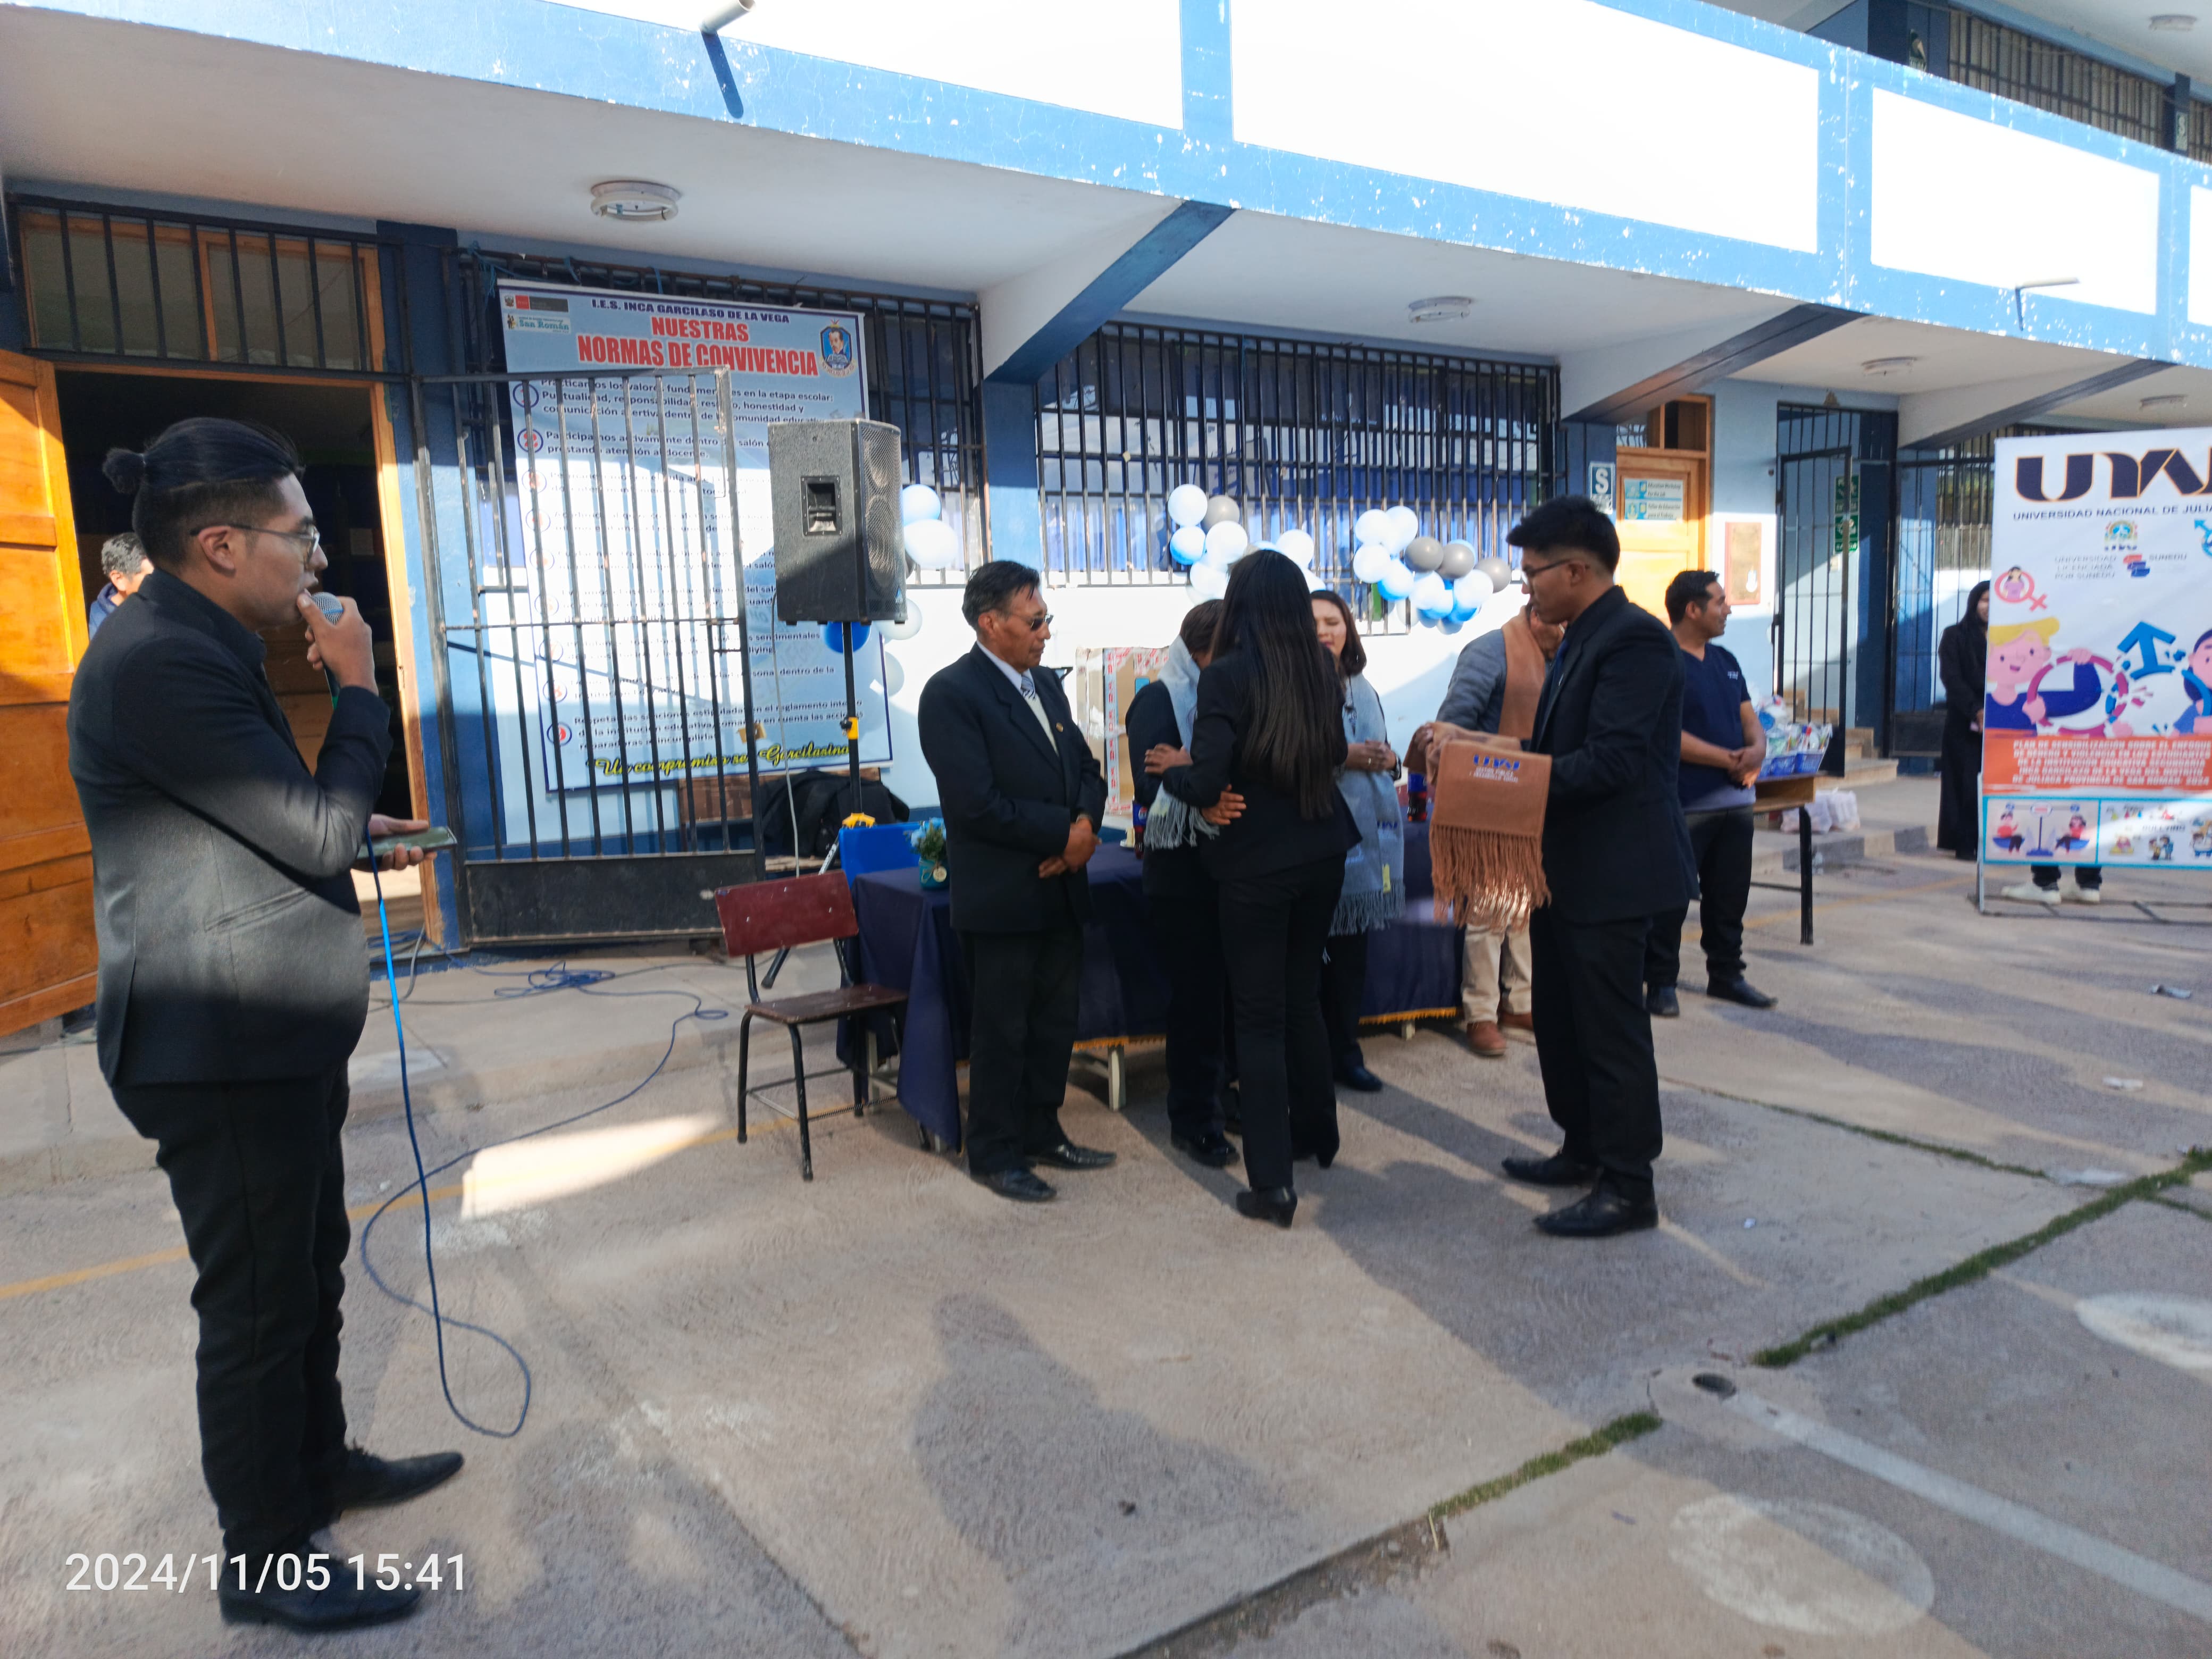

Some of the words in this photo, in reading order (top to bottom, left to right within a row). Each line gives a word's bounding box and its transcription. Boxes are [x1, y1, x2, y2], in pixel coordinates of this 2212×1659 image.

[592, 299, 621, 310] I.E.S.
[624, 301, 655, 313] INCA
[657, 304, 725, 318] GARCILASO
[727, 311, 742, 320] DE
[744, 312, 759, 321] LA
[760, 313, 790, 324] VEGA
[519, 319, 535, 328] San
[651, 316, 749, 342] NUESTRAS
[577, 334, 664, 367] NORMAS
[668, 341, 692, 367] DE
[696, 343, 819, 376] CONVIVENCIA
[629, 383, 664, 392] valore
[758, 389, 767, 398] la
[769, 391, 795, 400] etapa
[743, 400, 796, 411] honestidad
[665, 410, 692, 418] dentr
[738, 438, 764, 447] salón
[605, 447, 650, 456] atenión
[666, 448, 709, 458] docene,
[2015, 446, 2212, 502] UNA
[1595, 468, 1609, 494] S
[2013, 508, 2093, 521] UNIVERSIDAD
[2096, 506, 2158, 517] NACIONAL
[2162, 505, 2179, 515] DE
[754, 560, 775, 569] saló
[745, 597, 773, 605] cuand
[756, 632, 820, 641] senimentales
[780, 667, 810, 676] dentro
[826, 665, 834, 674] la
